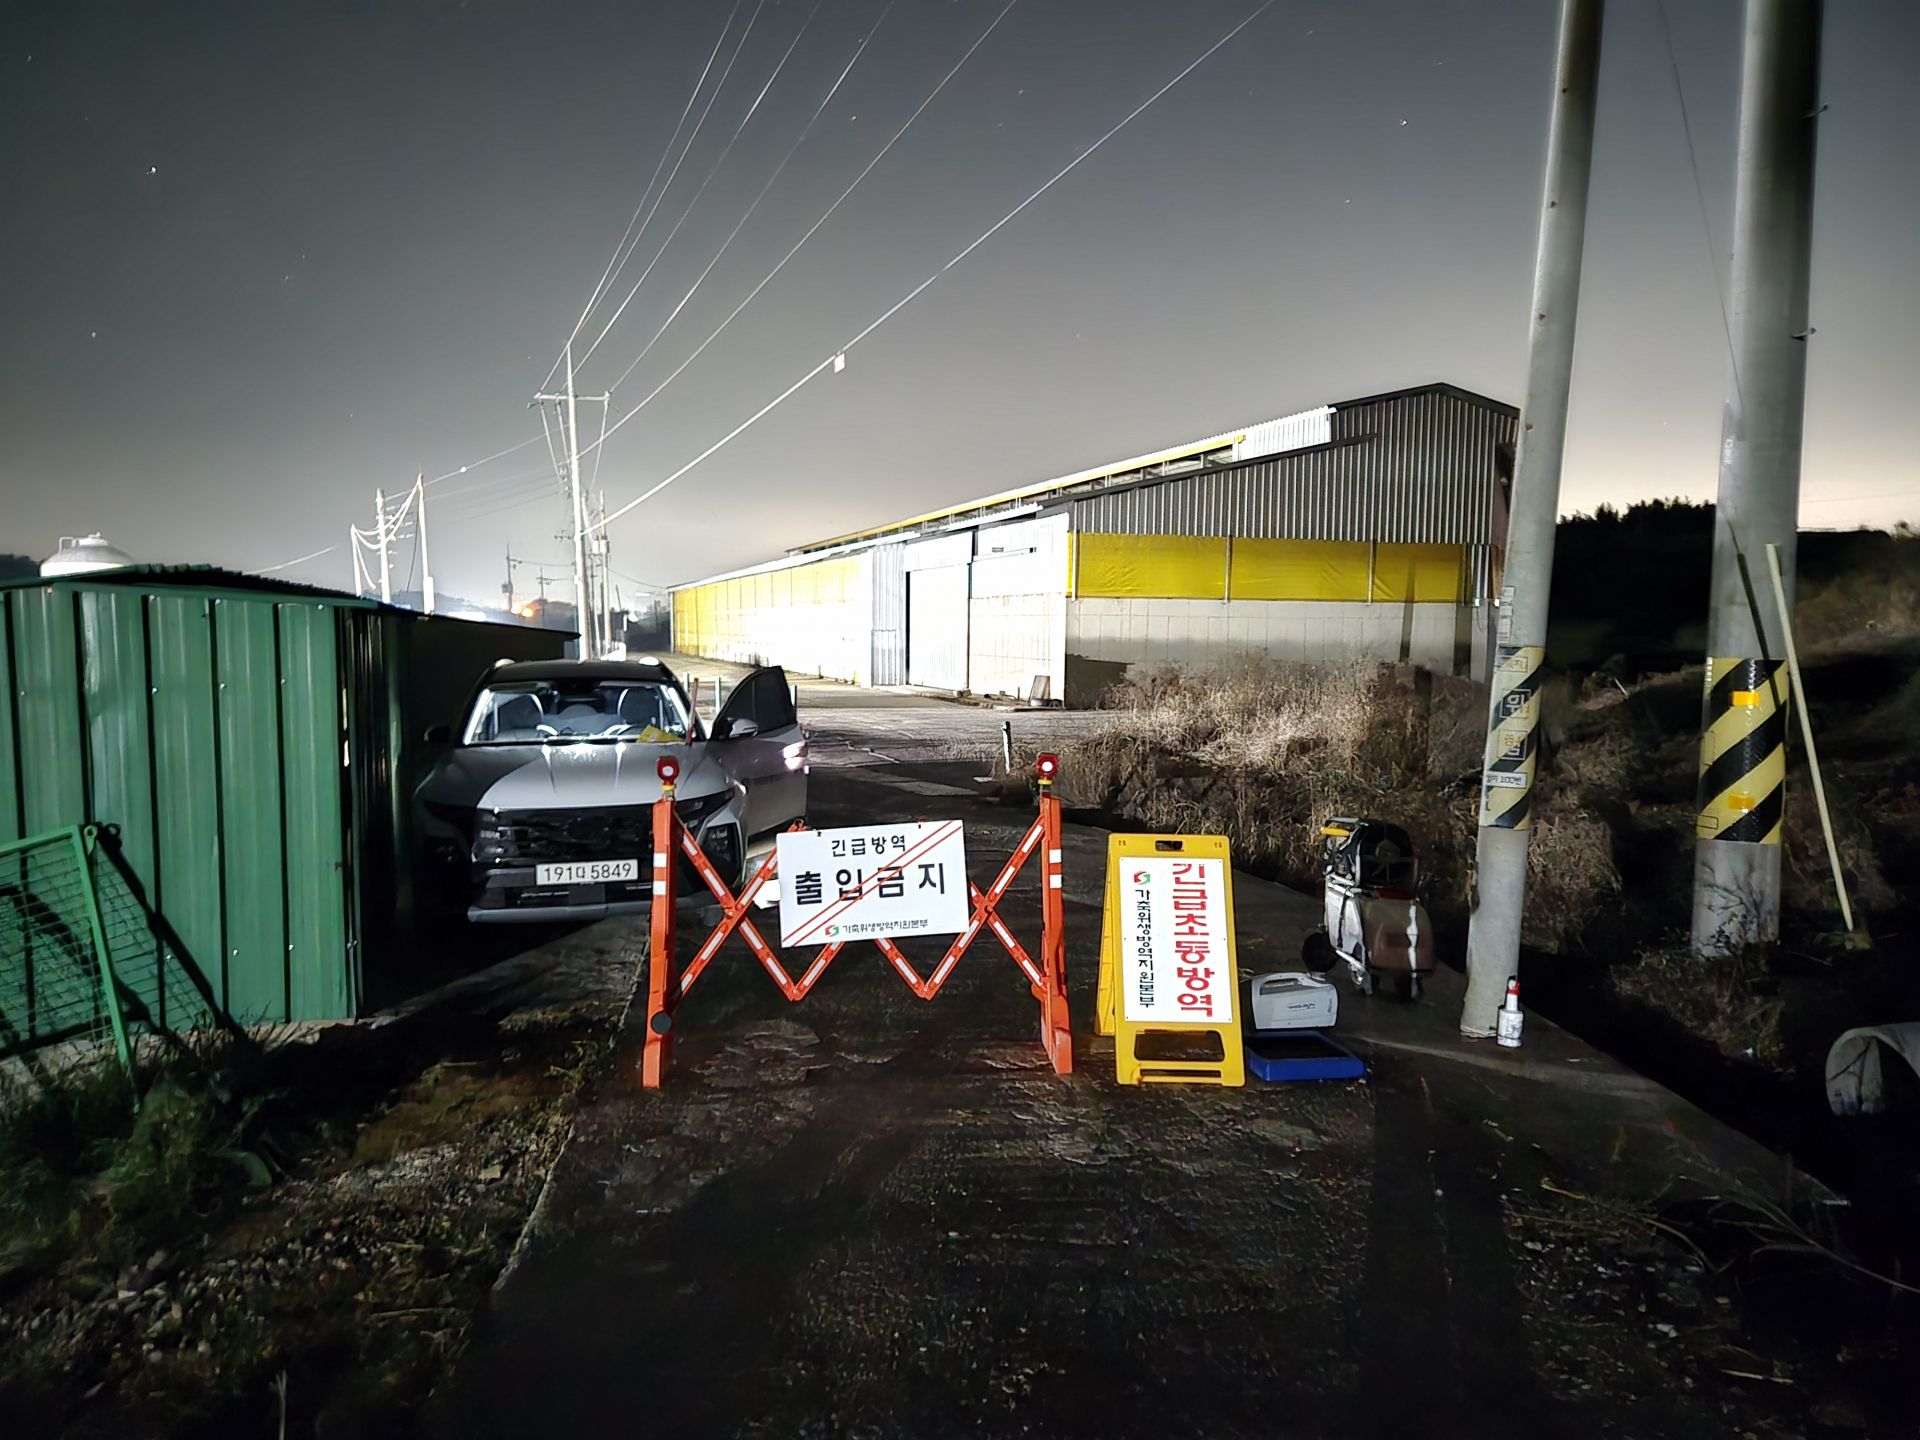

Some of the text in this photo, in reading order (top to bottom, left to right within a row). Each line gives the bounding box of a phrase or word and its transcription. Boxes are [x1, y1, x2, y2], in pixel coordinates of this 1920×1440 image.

[831, 835, 906, 857] 긴급방역
[795, 863, 945, 905] 출입금지
[842, 919, 928, 934] 가축위생방역지원본부
[1172, 864, 1215, 1017] 긴급초동방역
[1135, 889, 1154, 1008] 가축위생방역지원본부
